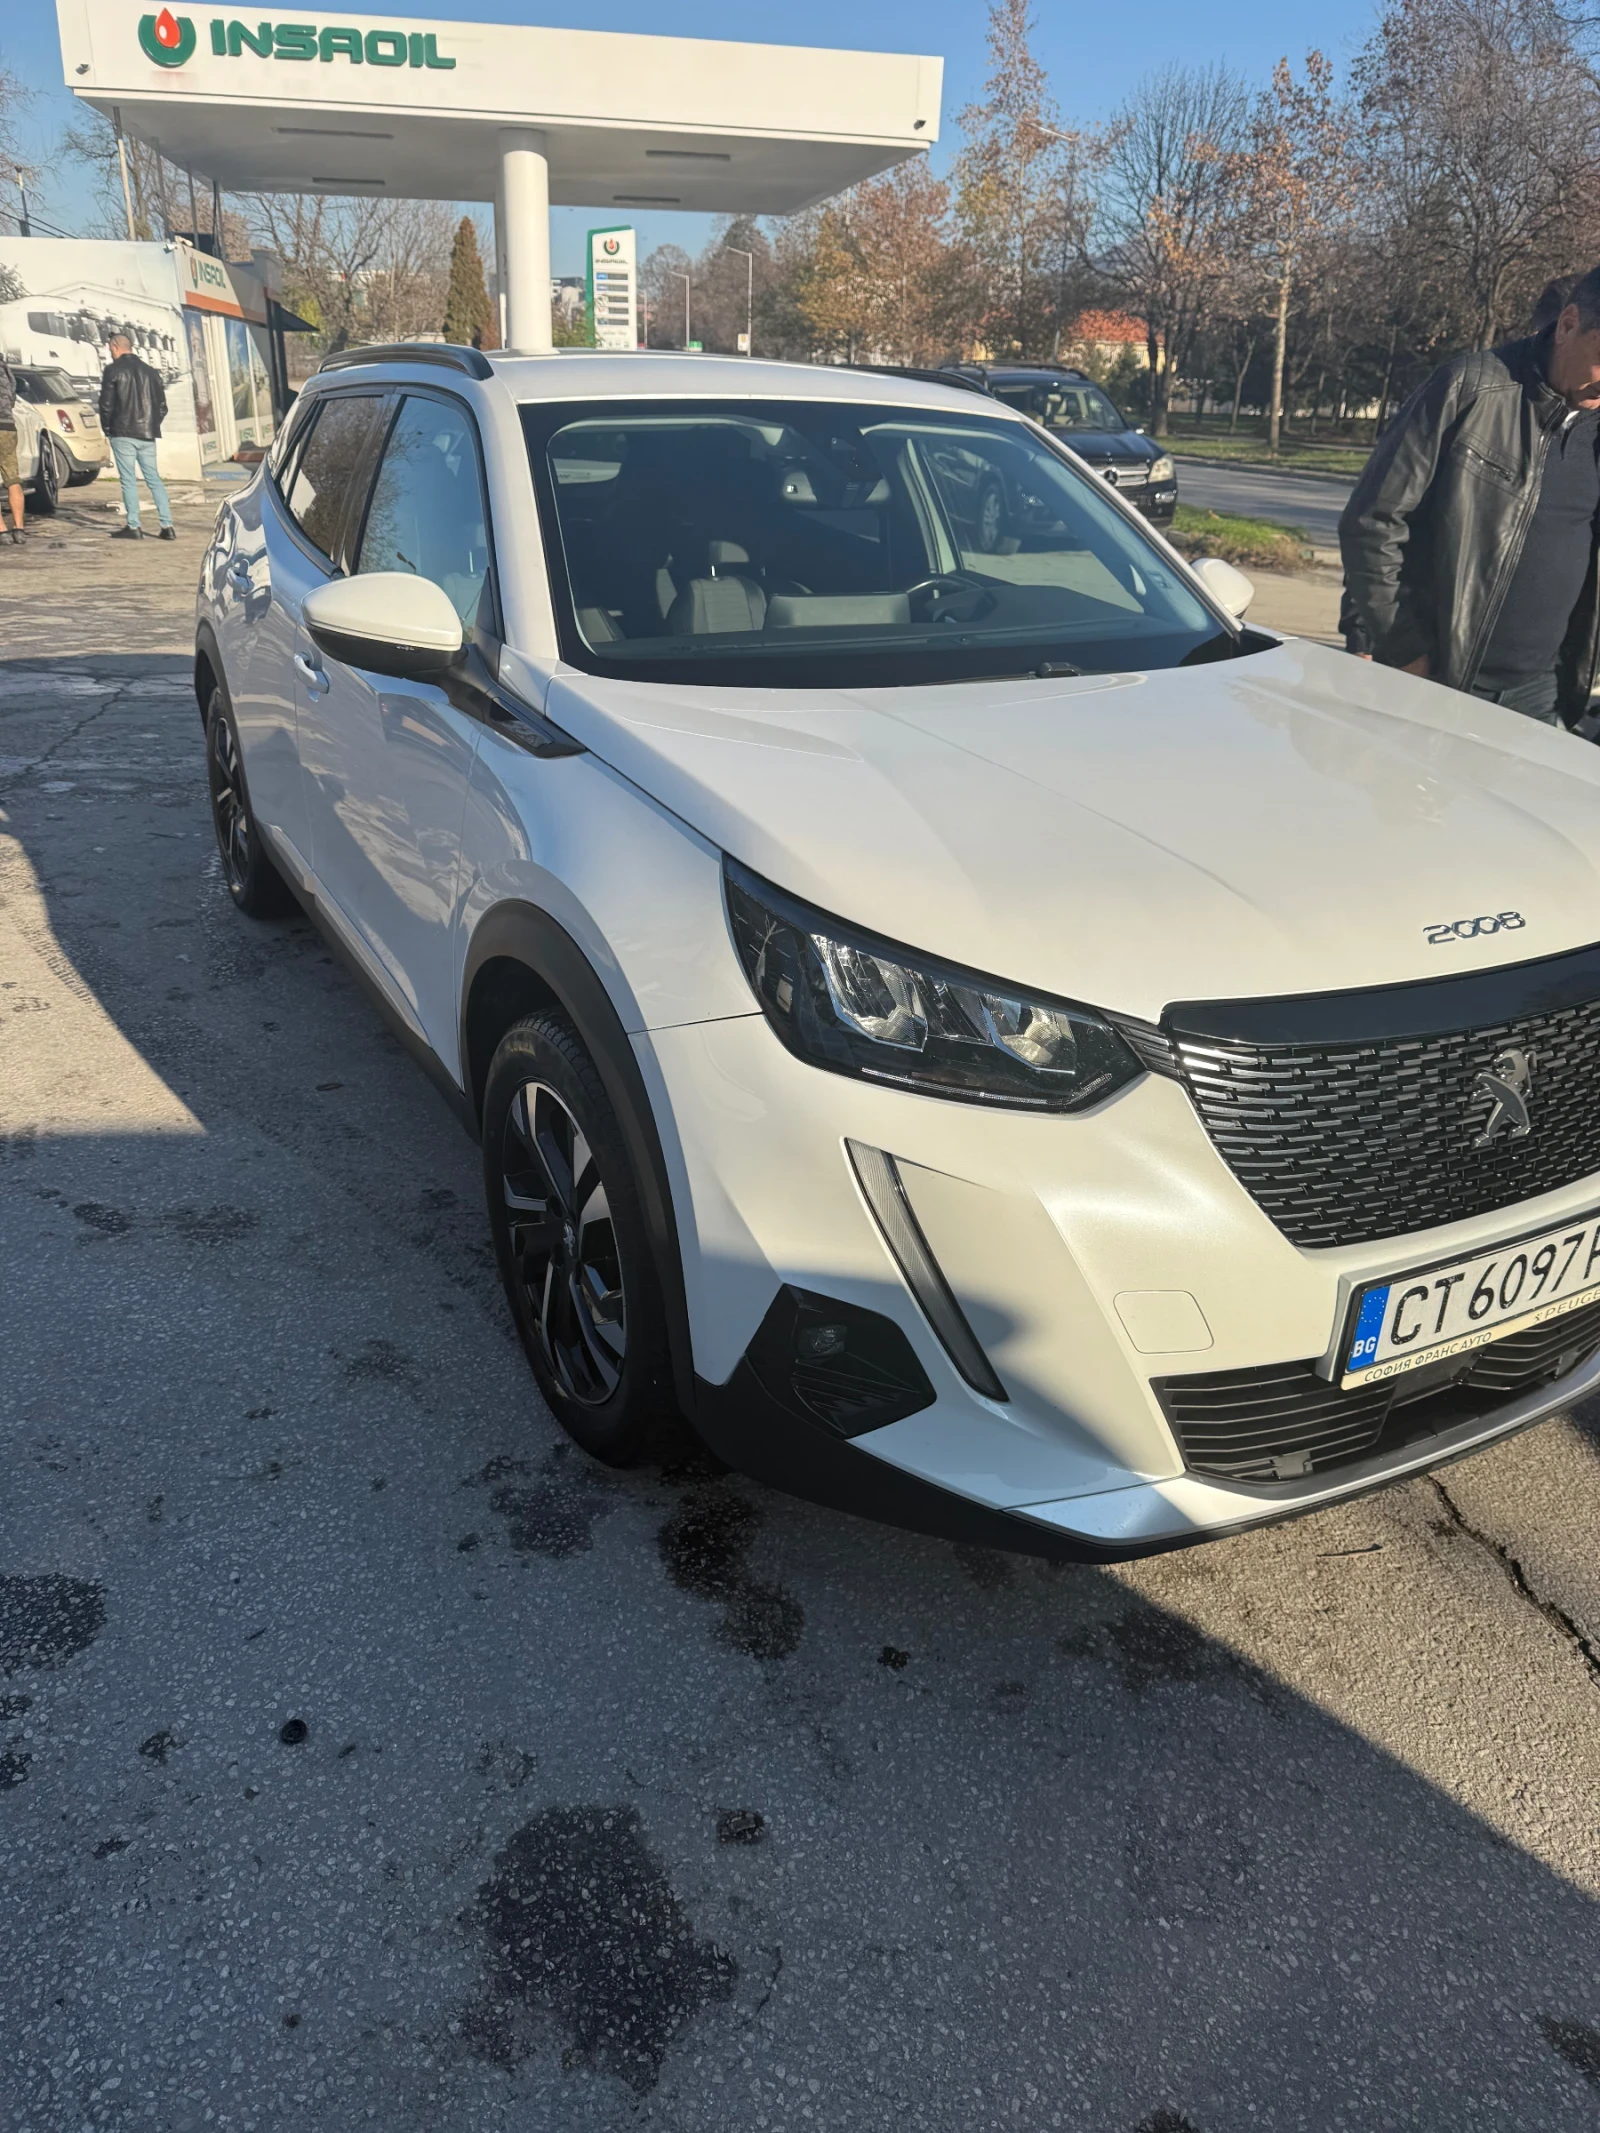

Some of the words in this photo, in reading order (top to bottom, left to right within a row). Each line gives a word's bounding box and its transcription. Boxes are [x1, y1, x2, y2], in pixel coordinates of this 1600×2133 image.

[210, 19, 456, 69] INSAOIL
[1423, 911, 1526, 945] 2008
[1352, 1336, 1378, 1358] BG
[1364, 1358, 1411, 1382] СОФИЯ
[1415, 1342, 1459, 1366] ФРАНС
[1459, 1331, 1493, 1352] АУТО
